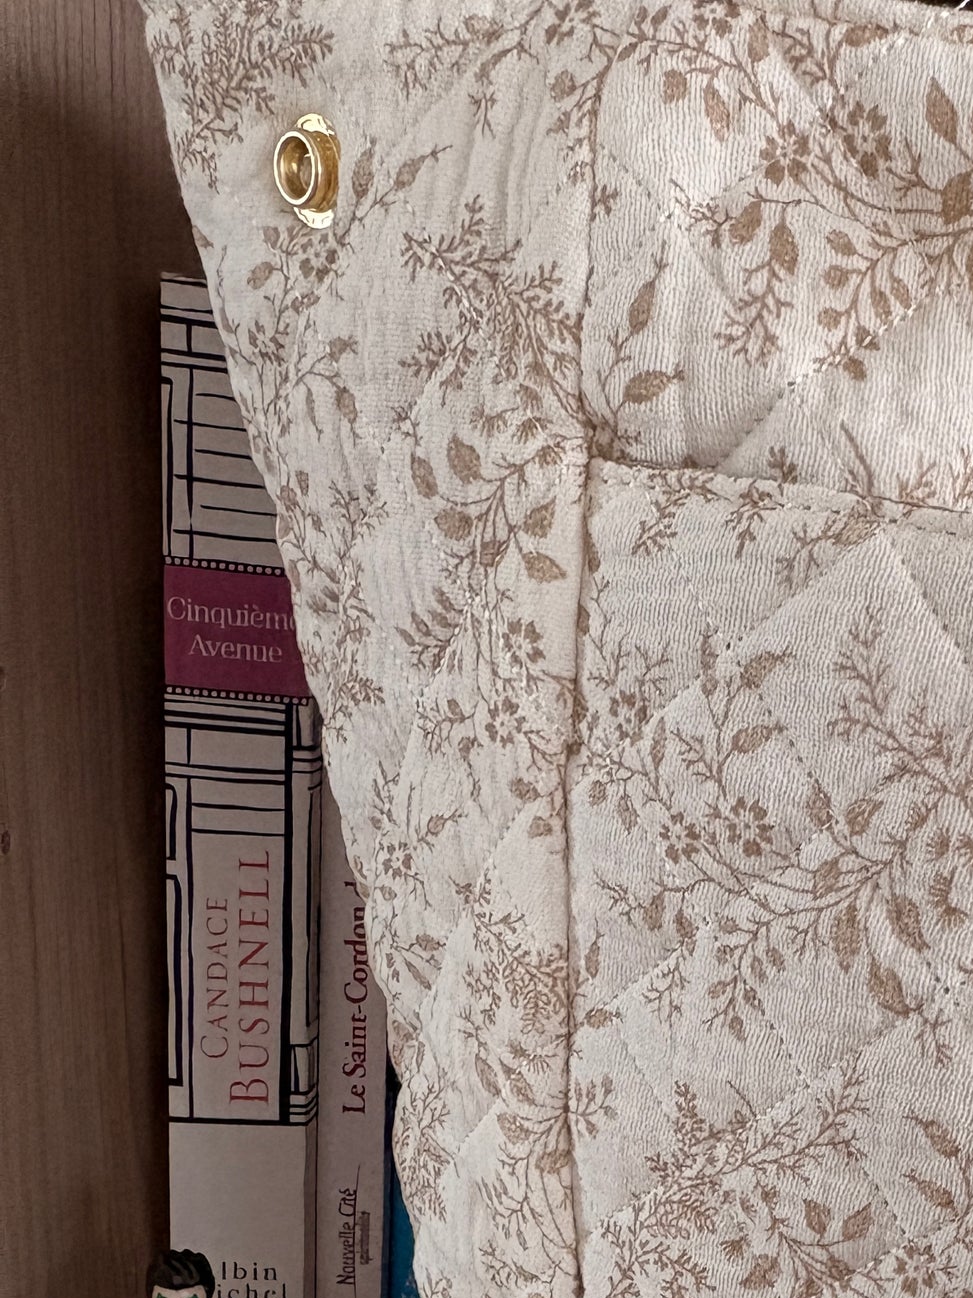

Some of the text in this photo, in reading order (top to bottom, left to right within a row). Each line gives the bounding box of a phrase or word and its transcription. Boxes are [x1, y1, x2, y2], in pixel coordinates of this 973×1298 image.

[188, 634, 283, 663] Avenue
[200, 897, 229, 1060] CANDACE
[229, 850, 270, 1105] BUSHNELL
[342, 1086, 366, 1114] Le
[221, 1261, 278, 1281] lbin
[336, 1221, 358, 1286] Nouvelle
